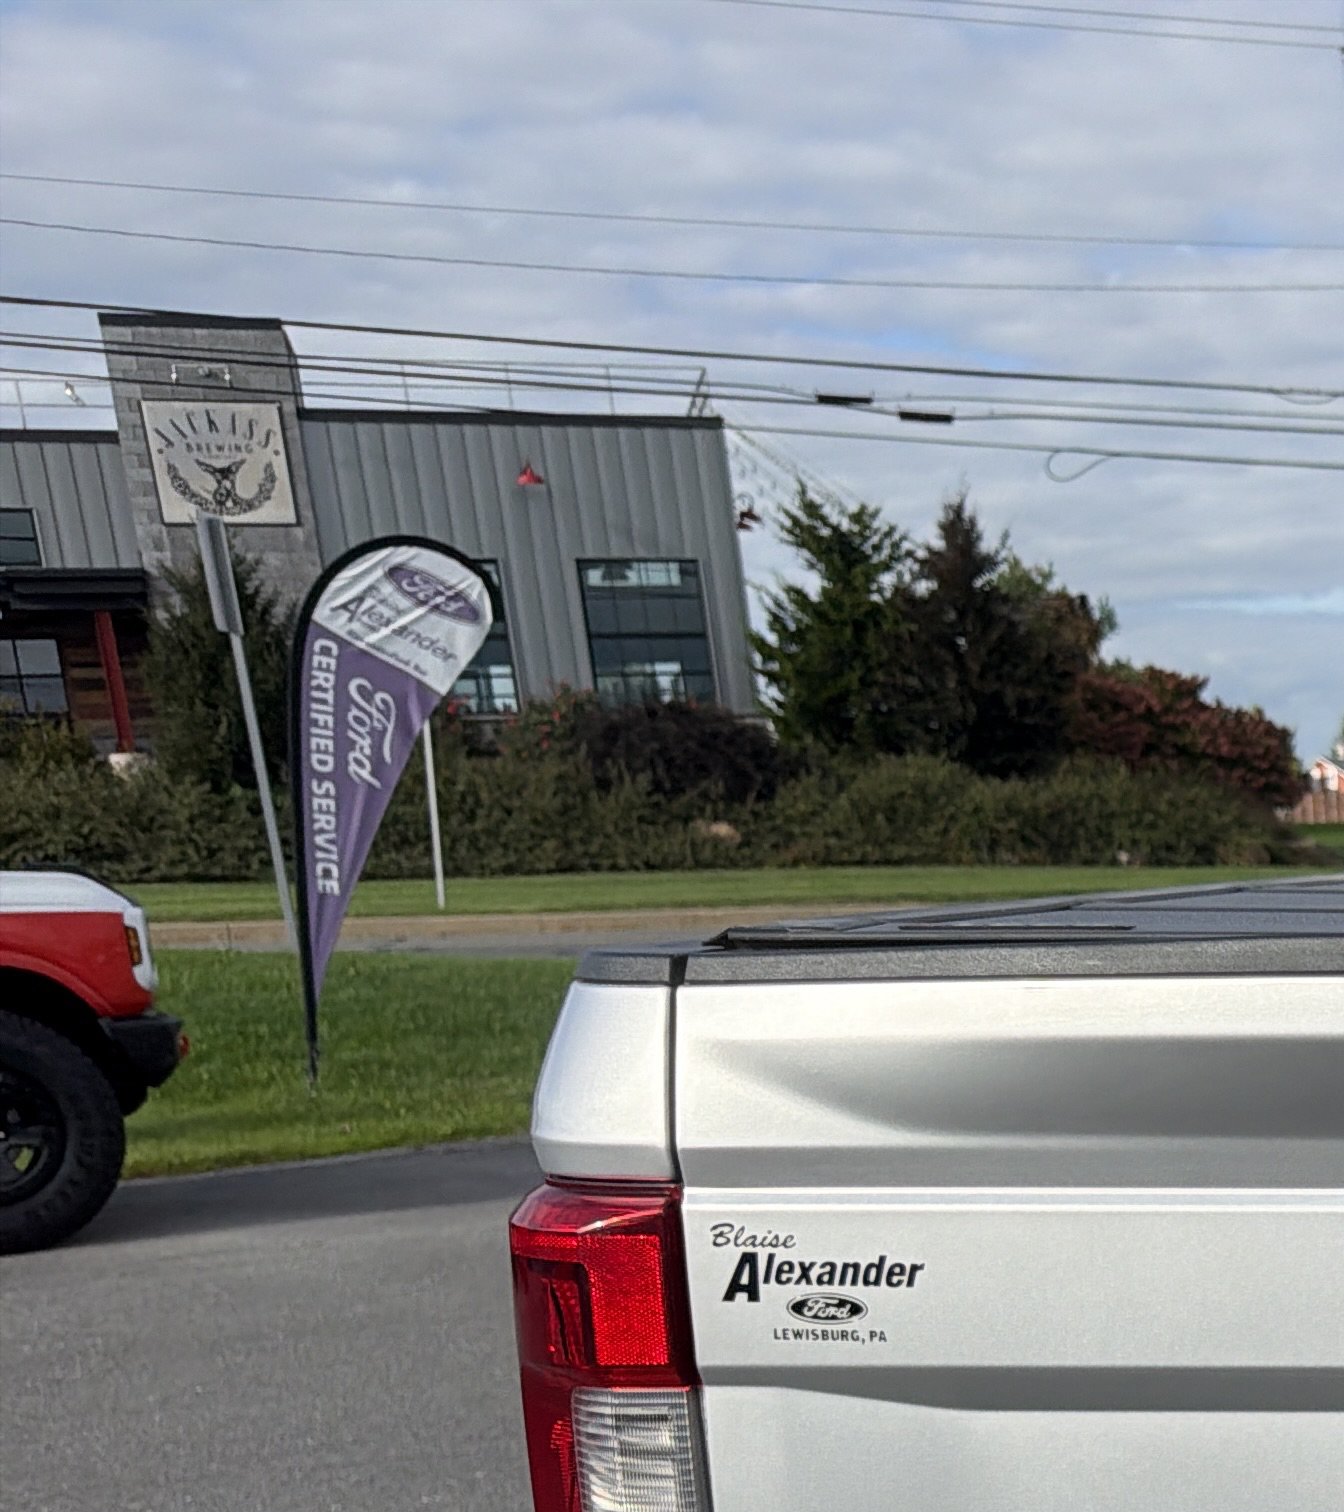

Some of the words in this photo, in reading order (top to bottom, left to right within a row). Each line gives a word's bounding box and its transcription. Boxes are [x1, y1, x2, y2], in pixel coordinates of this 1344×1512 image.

[310, 638, 339, 773] CERTIFIED
[348, 676, 398, 789] Ford
[311, 778, 341, 897] SERVICE
[710, 1223, 797, 1249] Blaise
[722, 1251, 925, 1303] Alexander
[802, 1298, 852, 1320] Ford
[773, 1327, 866, 1345] LEWISBURG,
[869, 1330, 888, 1343] PA
